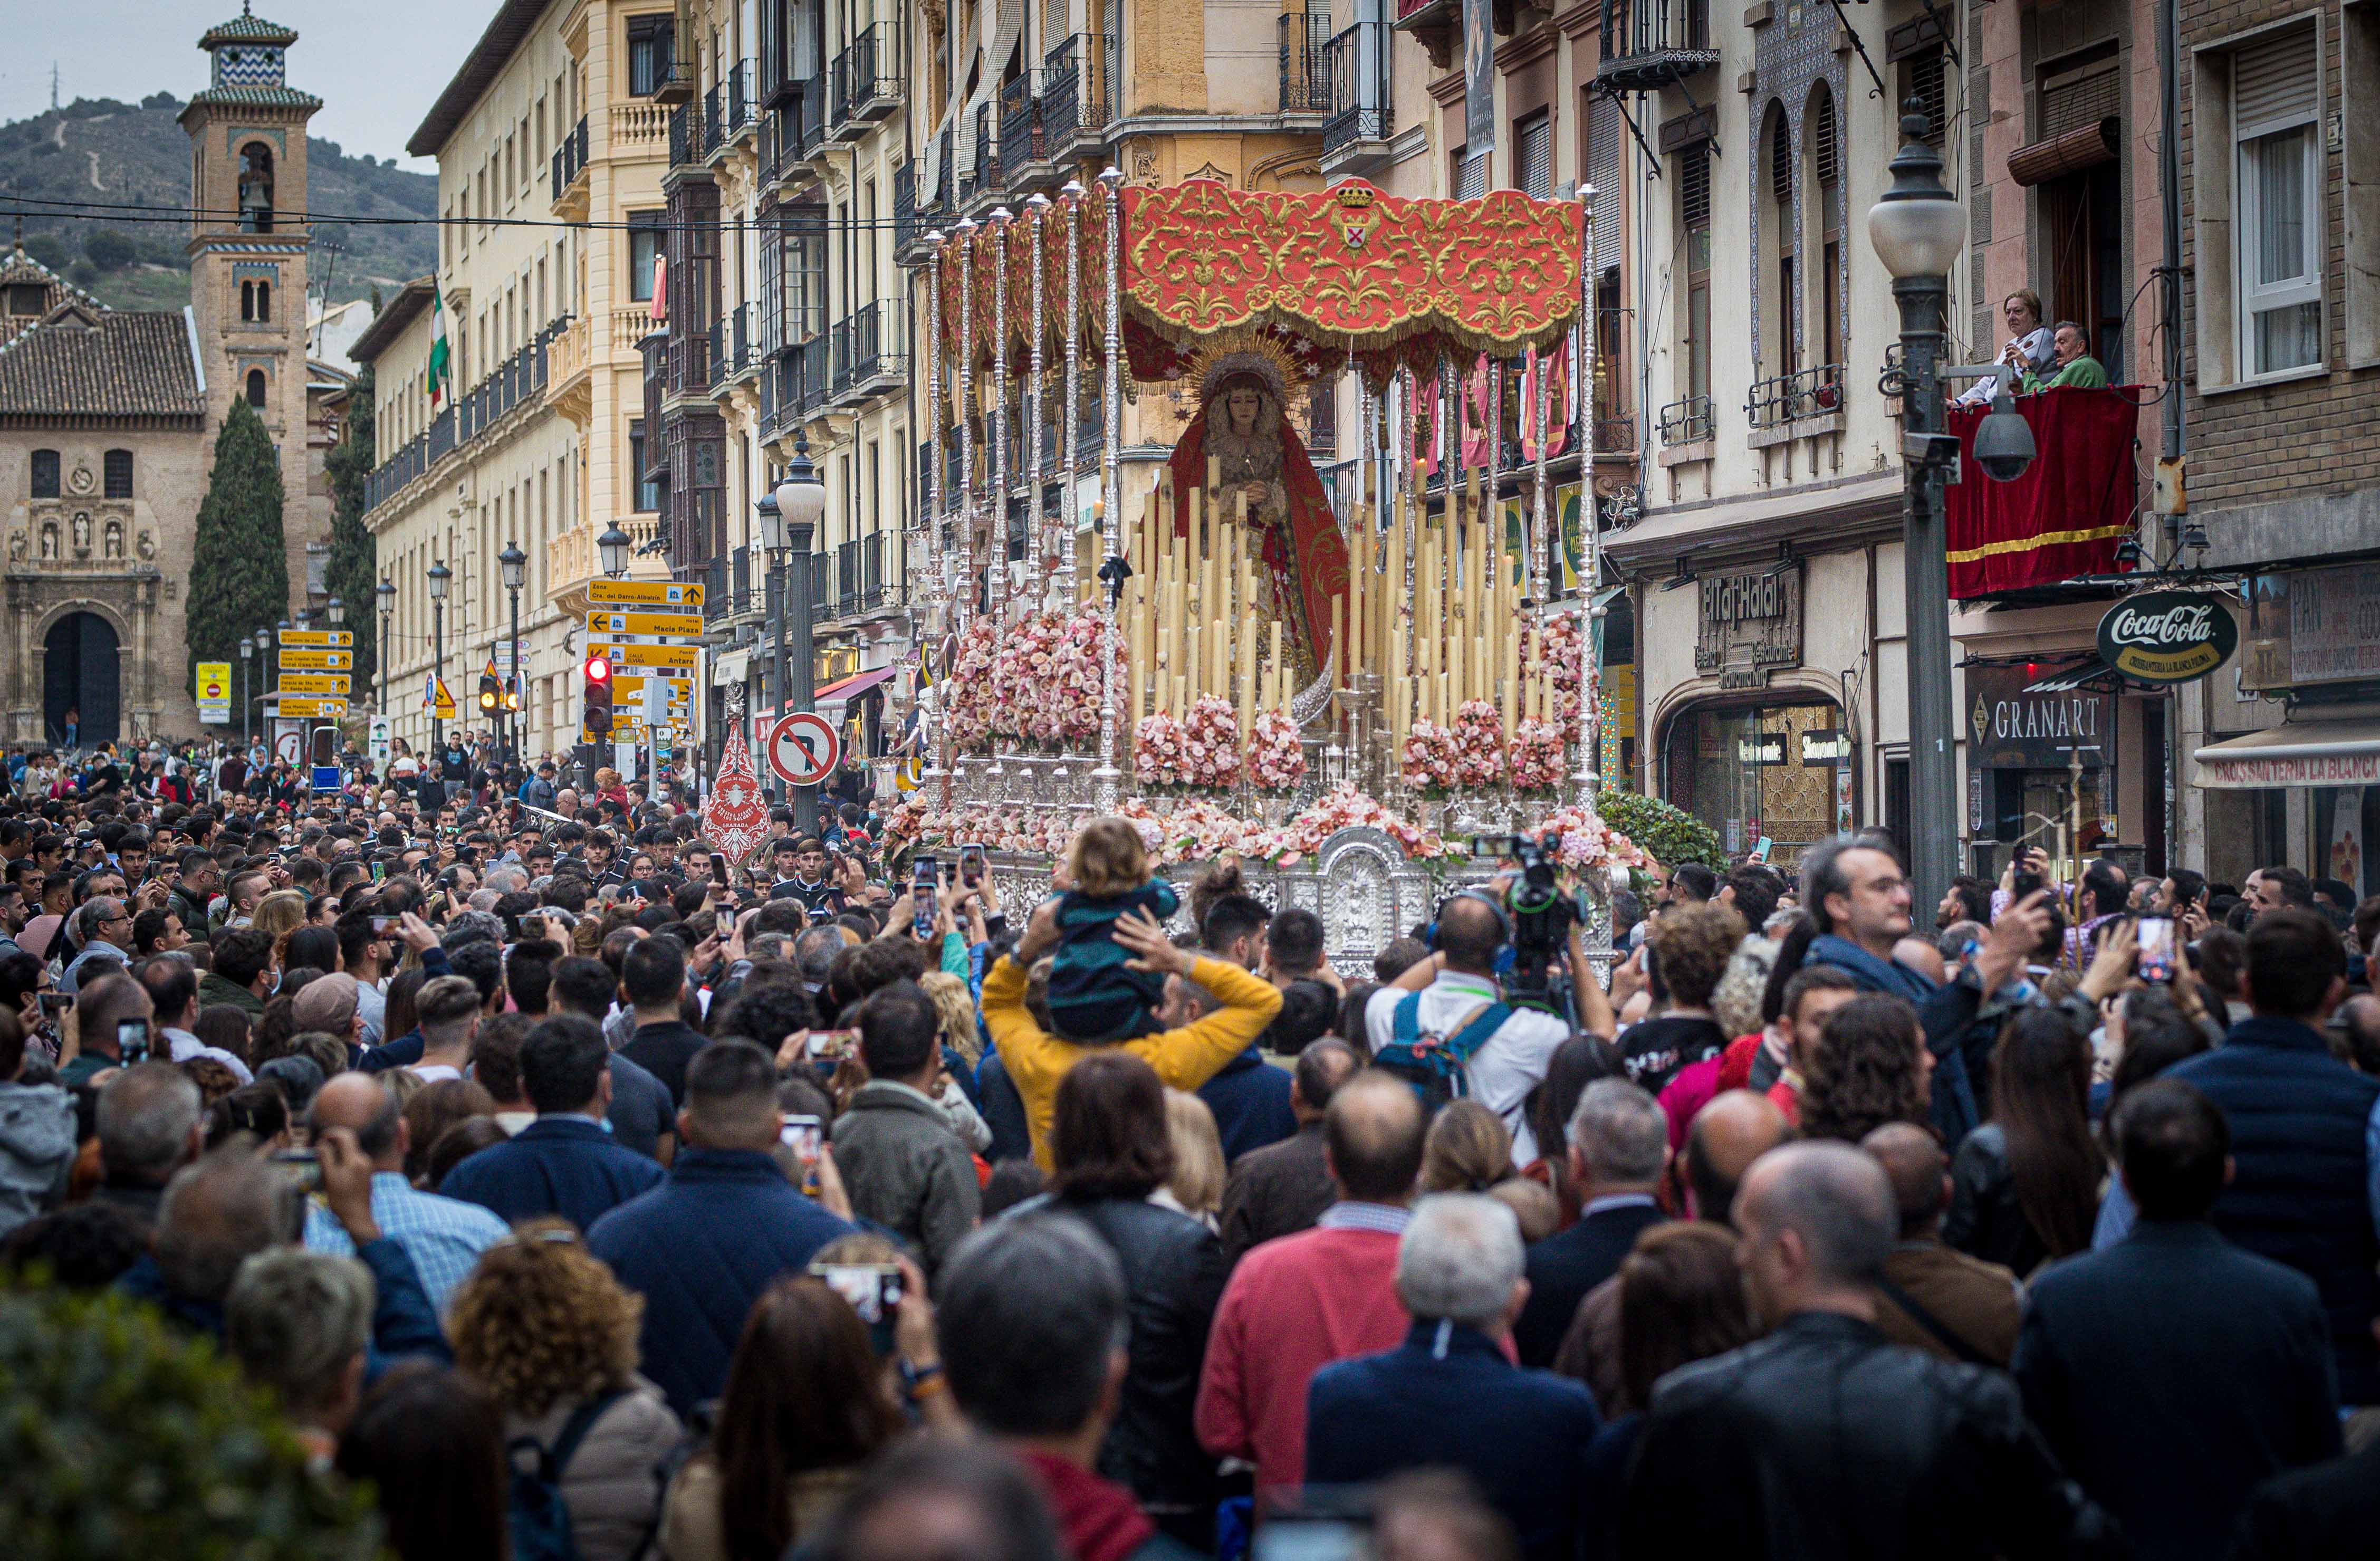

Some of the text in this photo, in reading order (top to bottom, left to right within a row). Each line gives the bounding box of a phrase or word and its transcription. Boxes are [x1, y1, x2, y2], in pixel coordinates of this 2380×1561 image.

[1996, 697, 2099, 739] GRANART
[1837, 734, 1851, 758] Kin
[2309, 758, 2326, 781] LA
[2327, 756, 2379, 780] BLANCA
